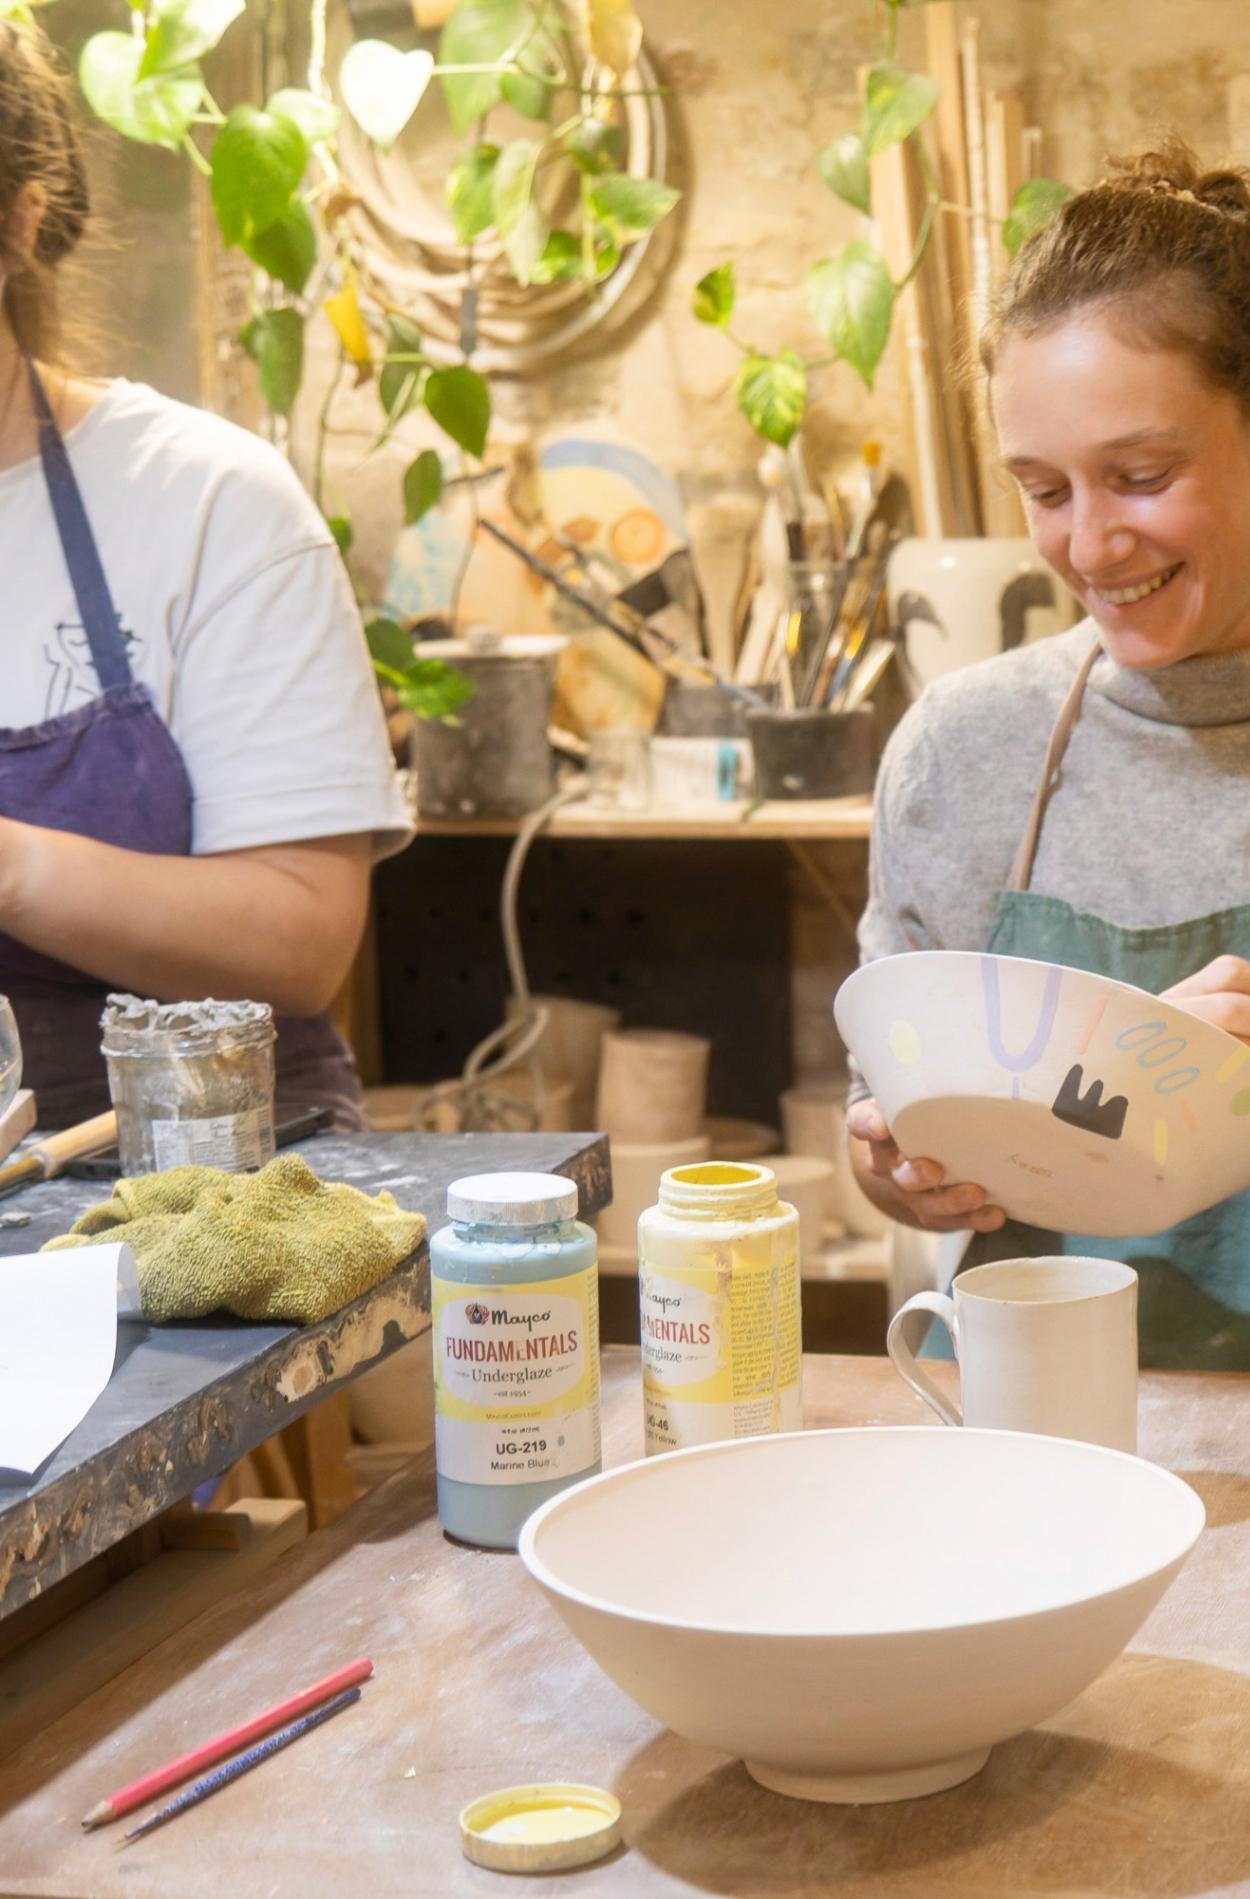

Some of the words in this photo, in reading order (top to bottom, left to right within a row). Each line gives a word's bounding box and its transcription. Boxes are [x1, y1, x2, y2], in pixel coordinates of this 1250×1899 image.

[491, 1310, 551, 1332] Mayco
[472, 1367, 553, 1385] Underglaze
[495, 1440, 547, 1455] UG-219
[490, 1460, 525, 1471] Marine
[527, 1459, 551, 1469] Blue
